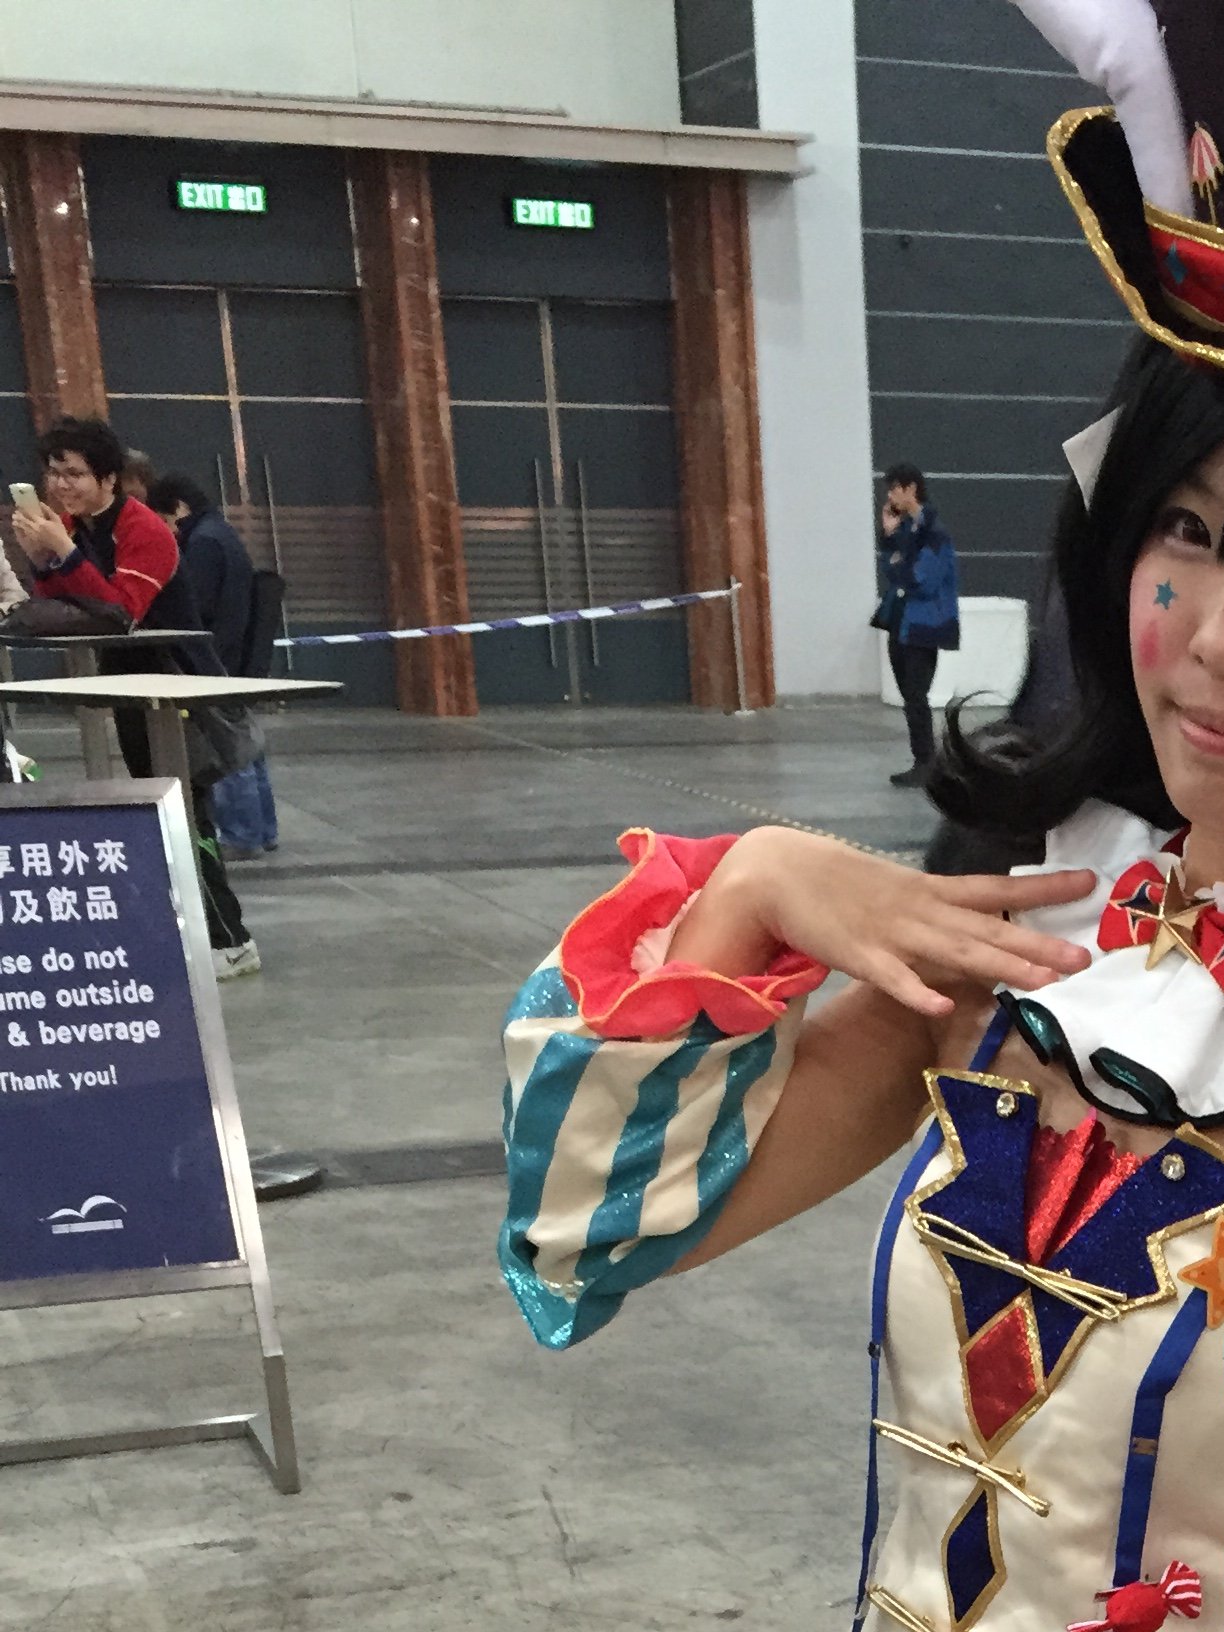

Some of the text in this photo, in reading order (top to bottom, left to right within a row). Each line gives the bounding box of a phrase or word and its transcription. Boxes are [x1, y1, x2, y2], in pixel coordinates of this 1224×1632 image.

[181, 182, 224, 209] EXIT
[516, 199, 556, 225] EXIT
[0, 886, 119, 925] 及飲品
[0, 945, 129, 974] se do not
[56, 978, 155, 1008] outside
[8, 1020, 161, 1047] & beverage
[0, 1064, 118, 1092] Thank you!
